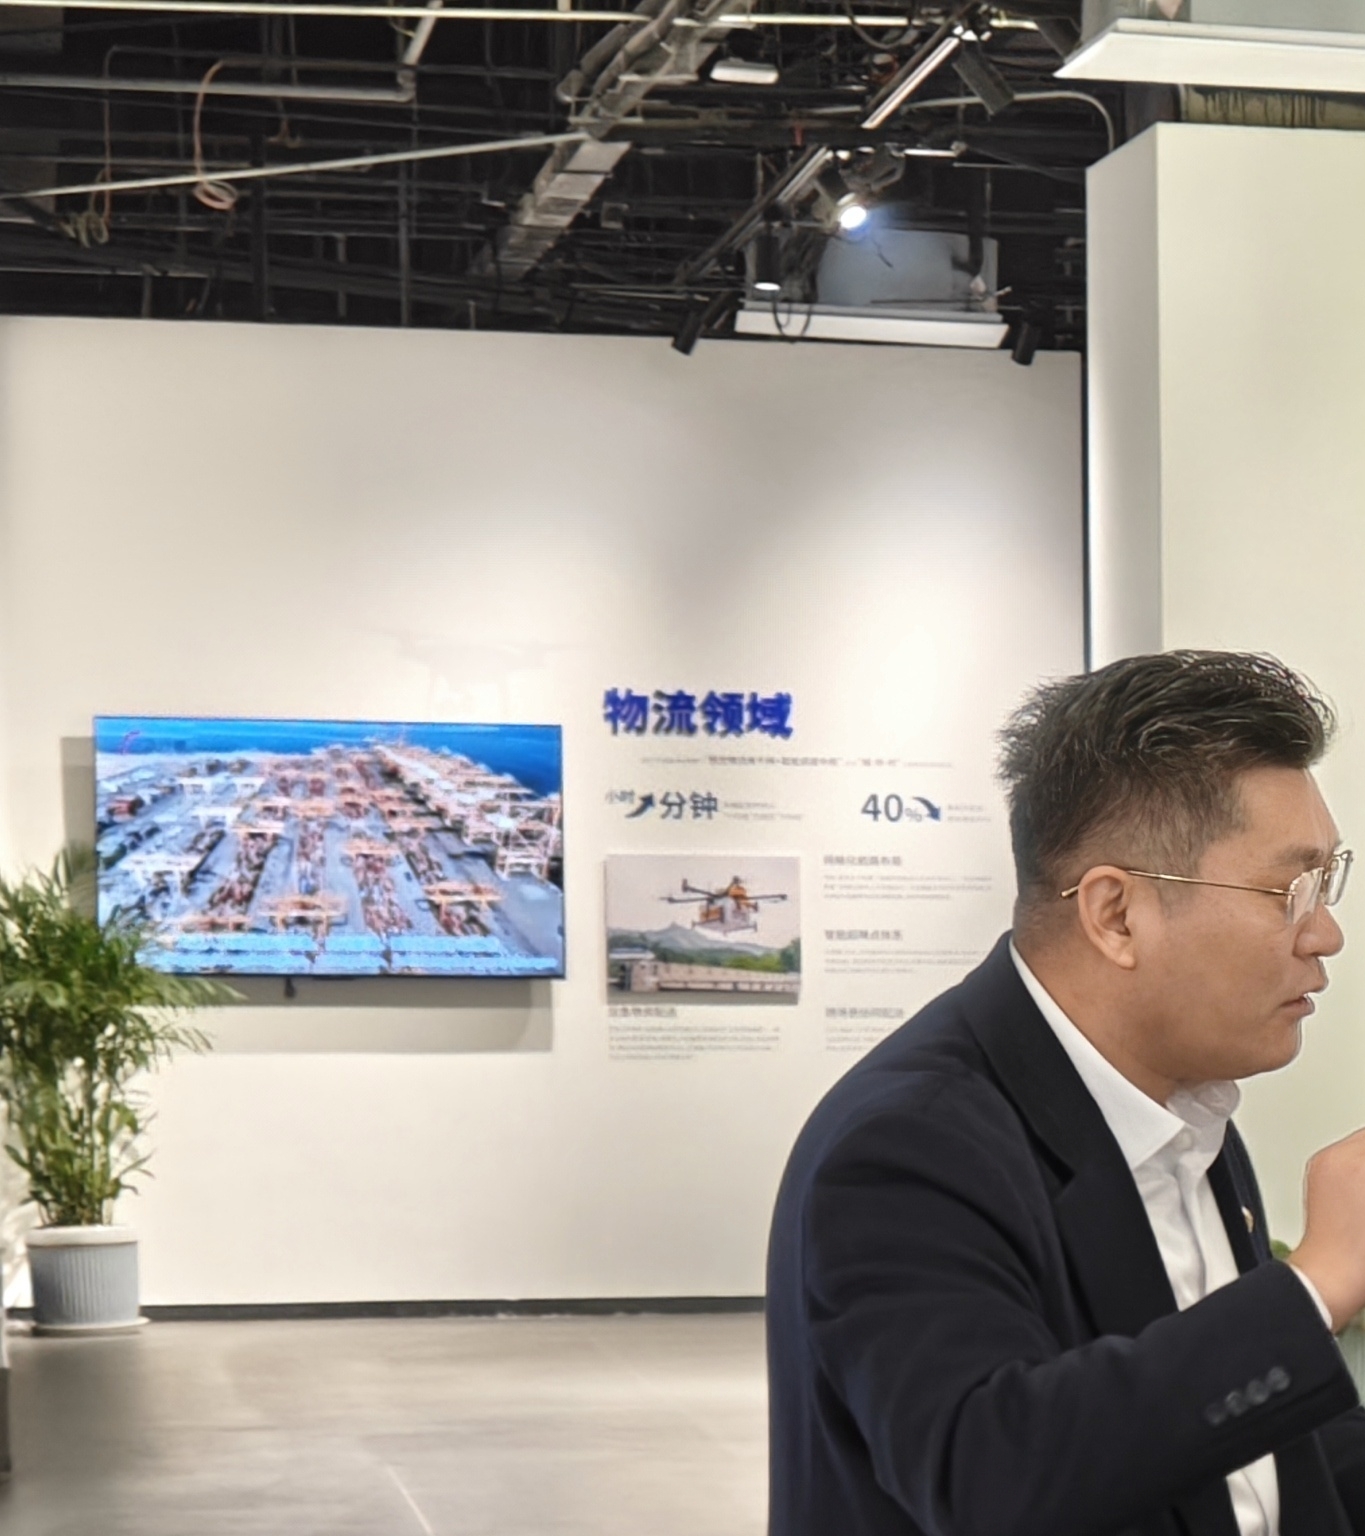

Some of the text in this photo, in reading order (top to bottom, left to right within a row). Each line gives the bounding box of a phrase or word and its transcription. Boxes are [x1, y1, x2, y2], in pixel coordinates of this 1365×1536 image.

[603, 688, 794, 738] 物流领域
[659, 791, 718, 820] 分钟
